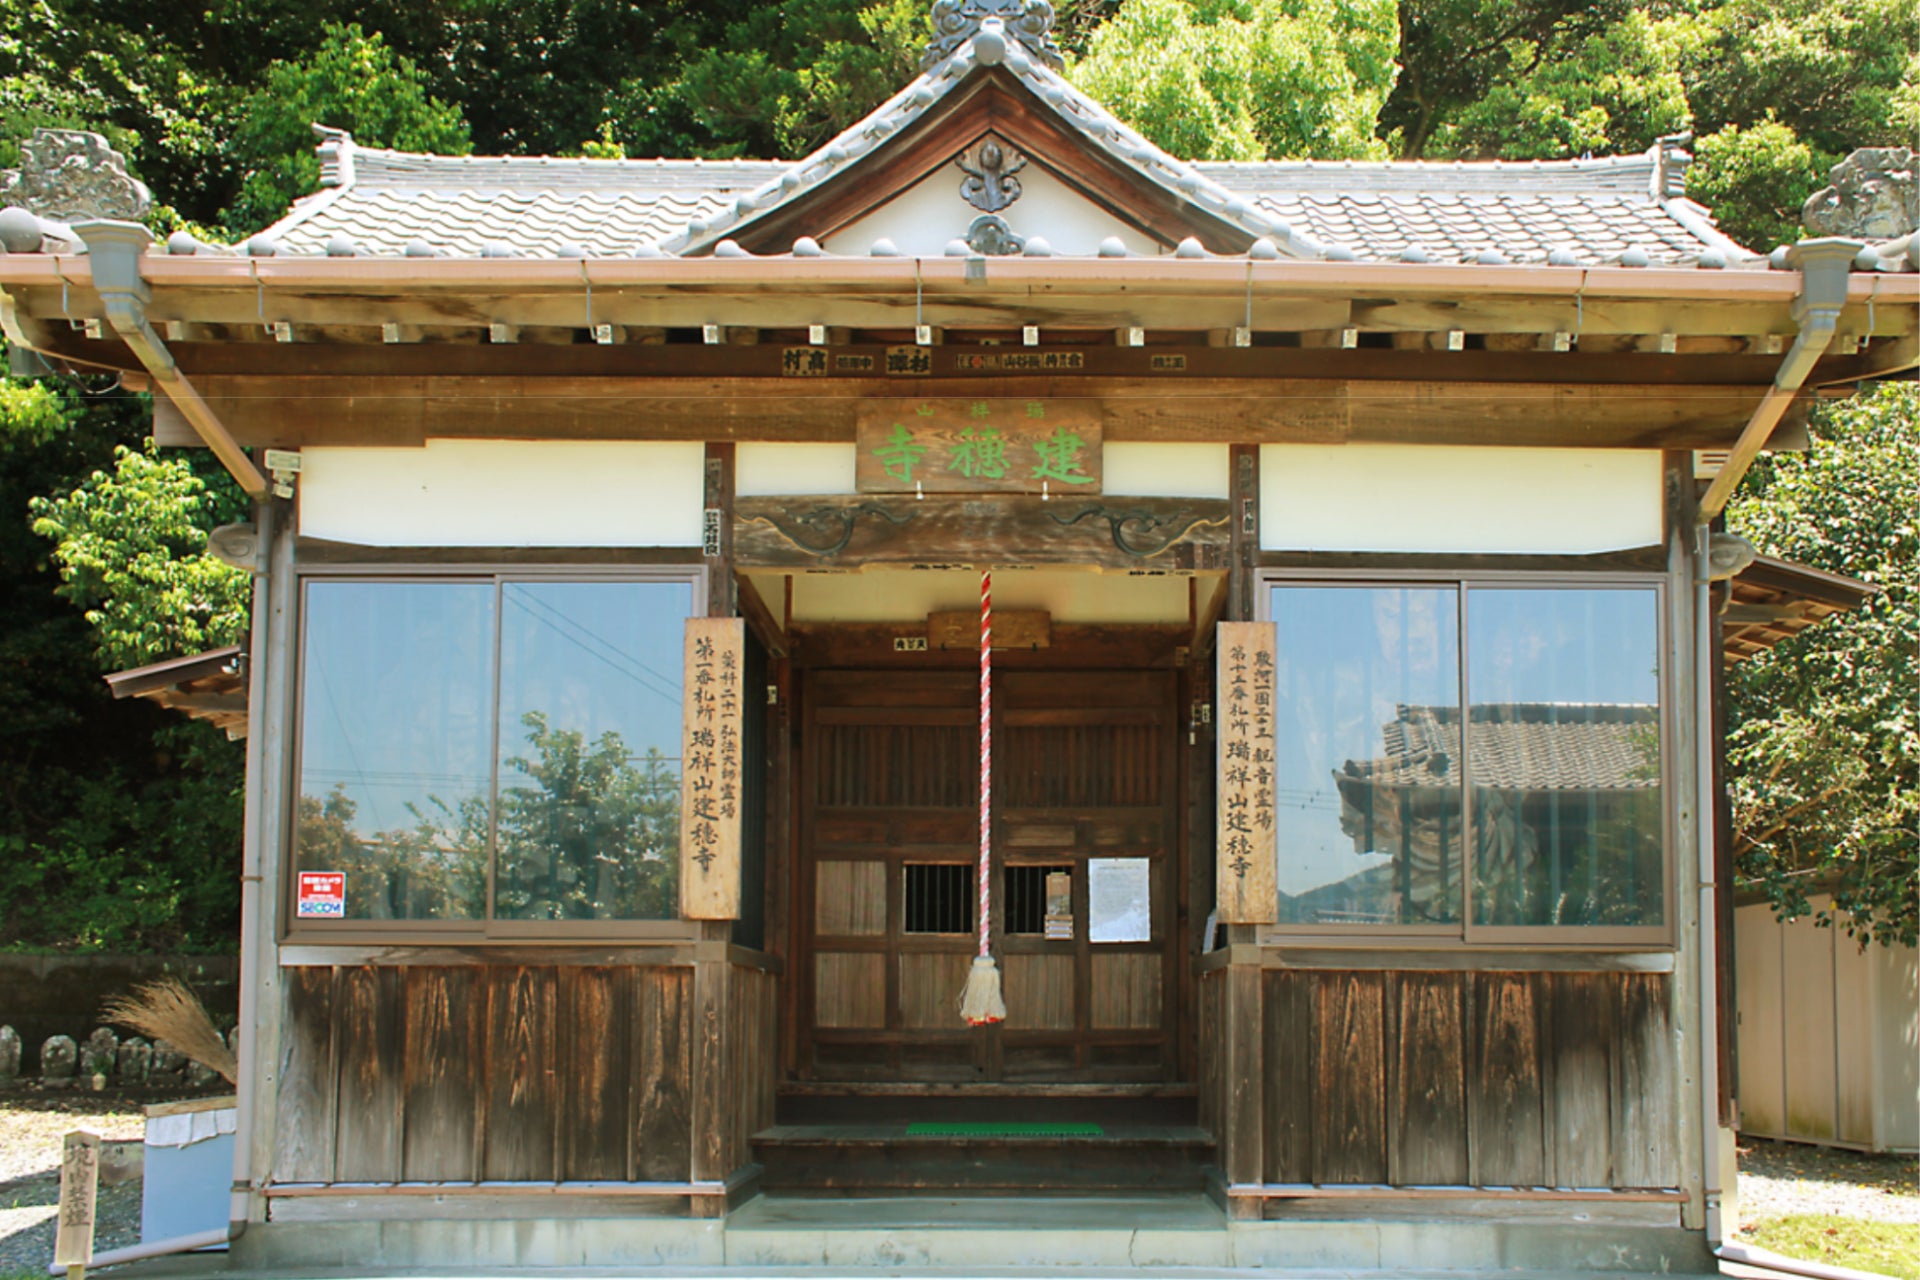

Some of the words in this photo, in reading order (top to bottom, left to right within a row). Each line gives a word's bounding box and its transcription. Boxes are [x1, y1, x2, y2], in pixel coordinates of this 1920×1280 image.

[871, 422, 1096, 484] 建穂寺
[300, 902, 341, 913] SECOM
